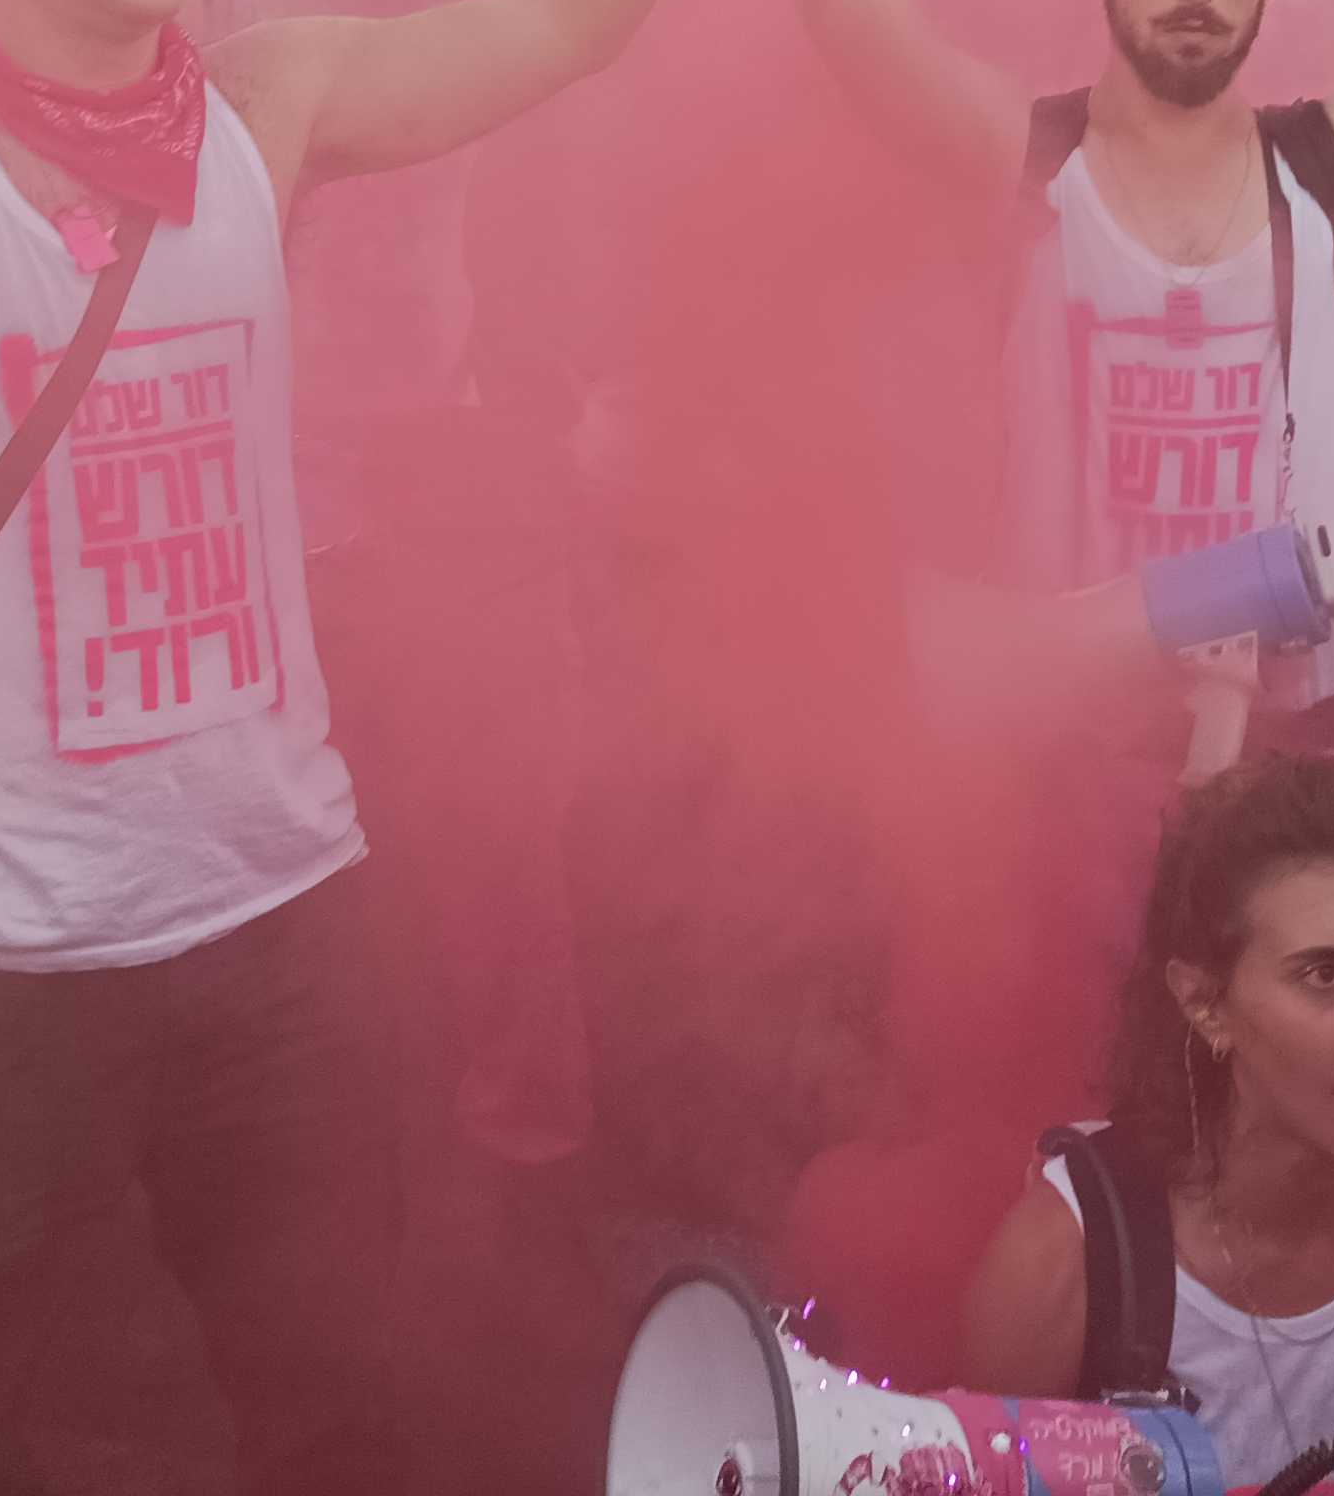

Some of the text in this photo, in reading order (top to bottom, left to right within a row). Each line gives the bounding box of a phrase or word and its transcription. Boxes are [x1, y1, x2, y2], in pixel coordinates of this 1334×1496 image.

[170, 363, 230, 420] דור
[1108, 361, 1262, 411] דור שלם
[73, 438, 239, 544] דורש
[1107, 430, 1259, 508] דורש
[80, 522, 248, 627] עתיד
[84, 605, 260, 718] ורוד!
